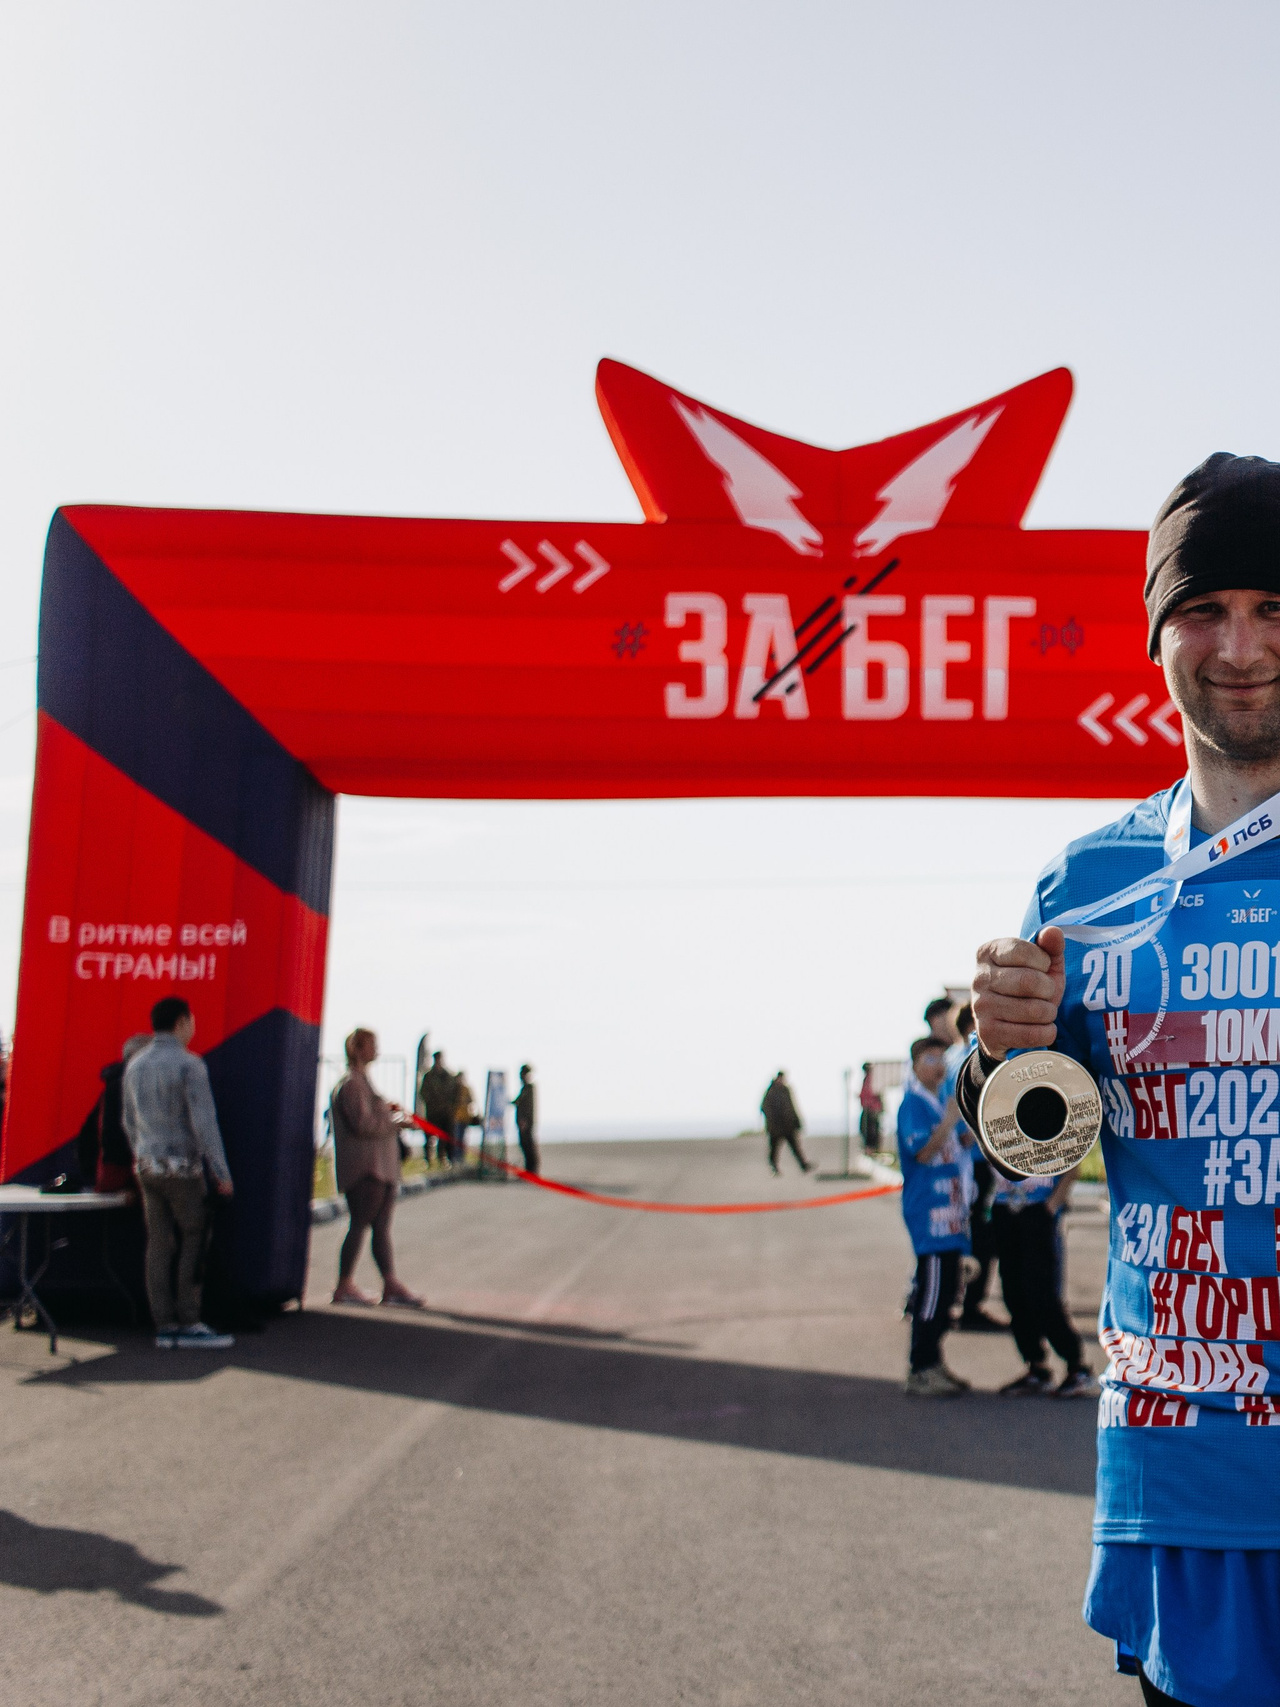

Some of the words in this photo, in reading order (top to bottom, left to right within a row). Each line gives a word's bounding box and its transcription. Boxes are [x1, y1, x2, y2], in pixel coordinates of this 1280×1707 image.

[1233, 814, 1273, 846] ПСБ
[49, 915, 70, 943] В
[78, 922, 172, 948] ритме
[180, 919, 248, 946] всей
[75, 950, 216, 980] СТРАНЫ!
[1117, 1203, 1228, 1274] #ЗАБЕГ
